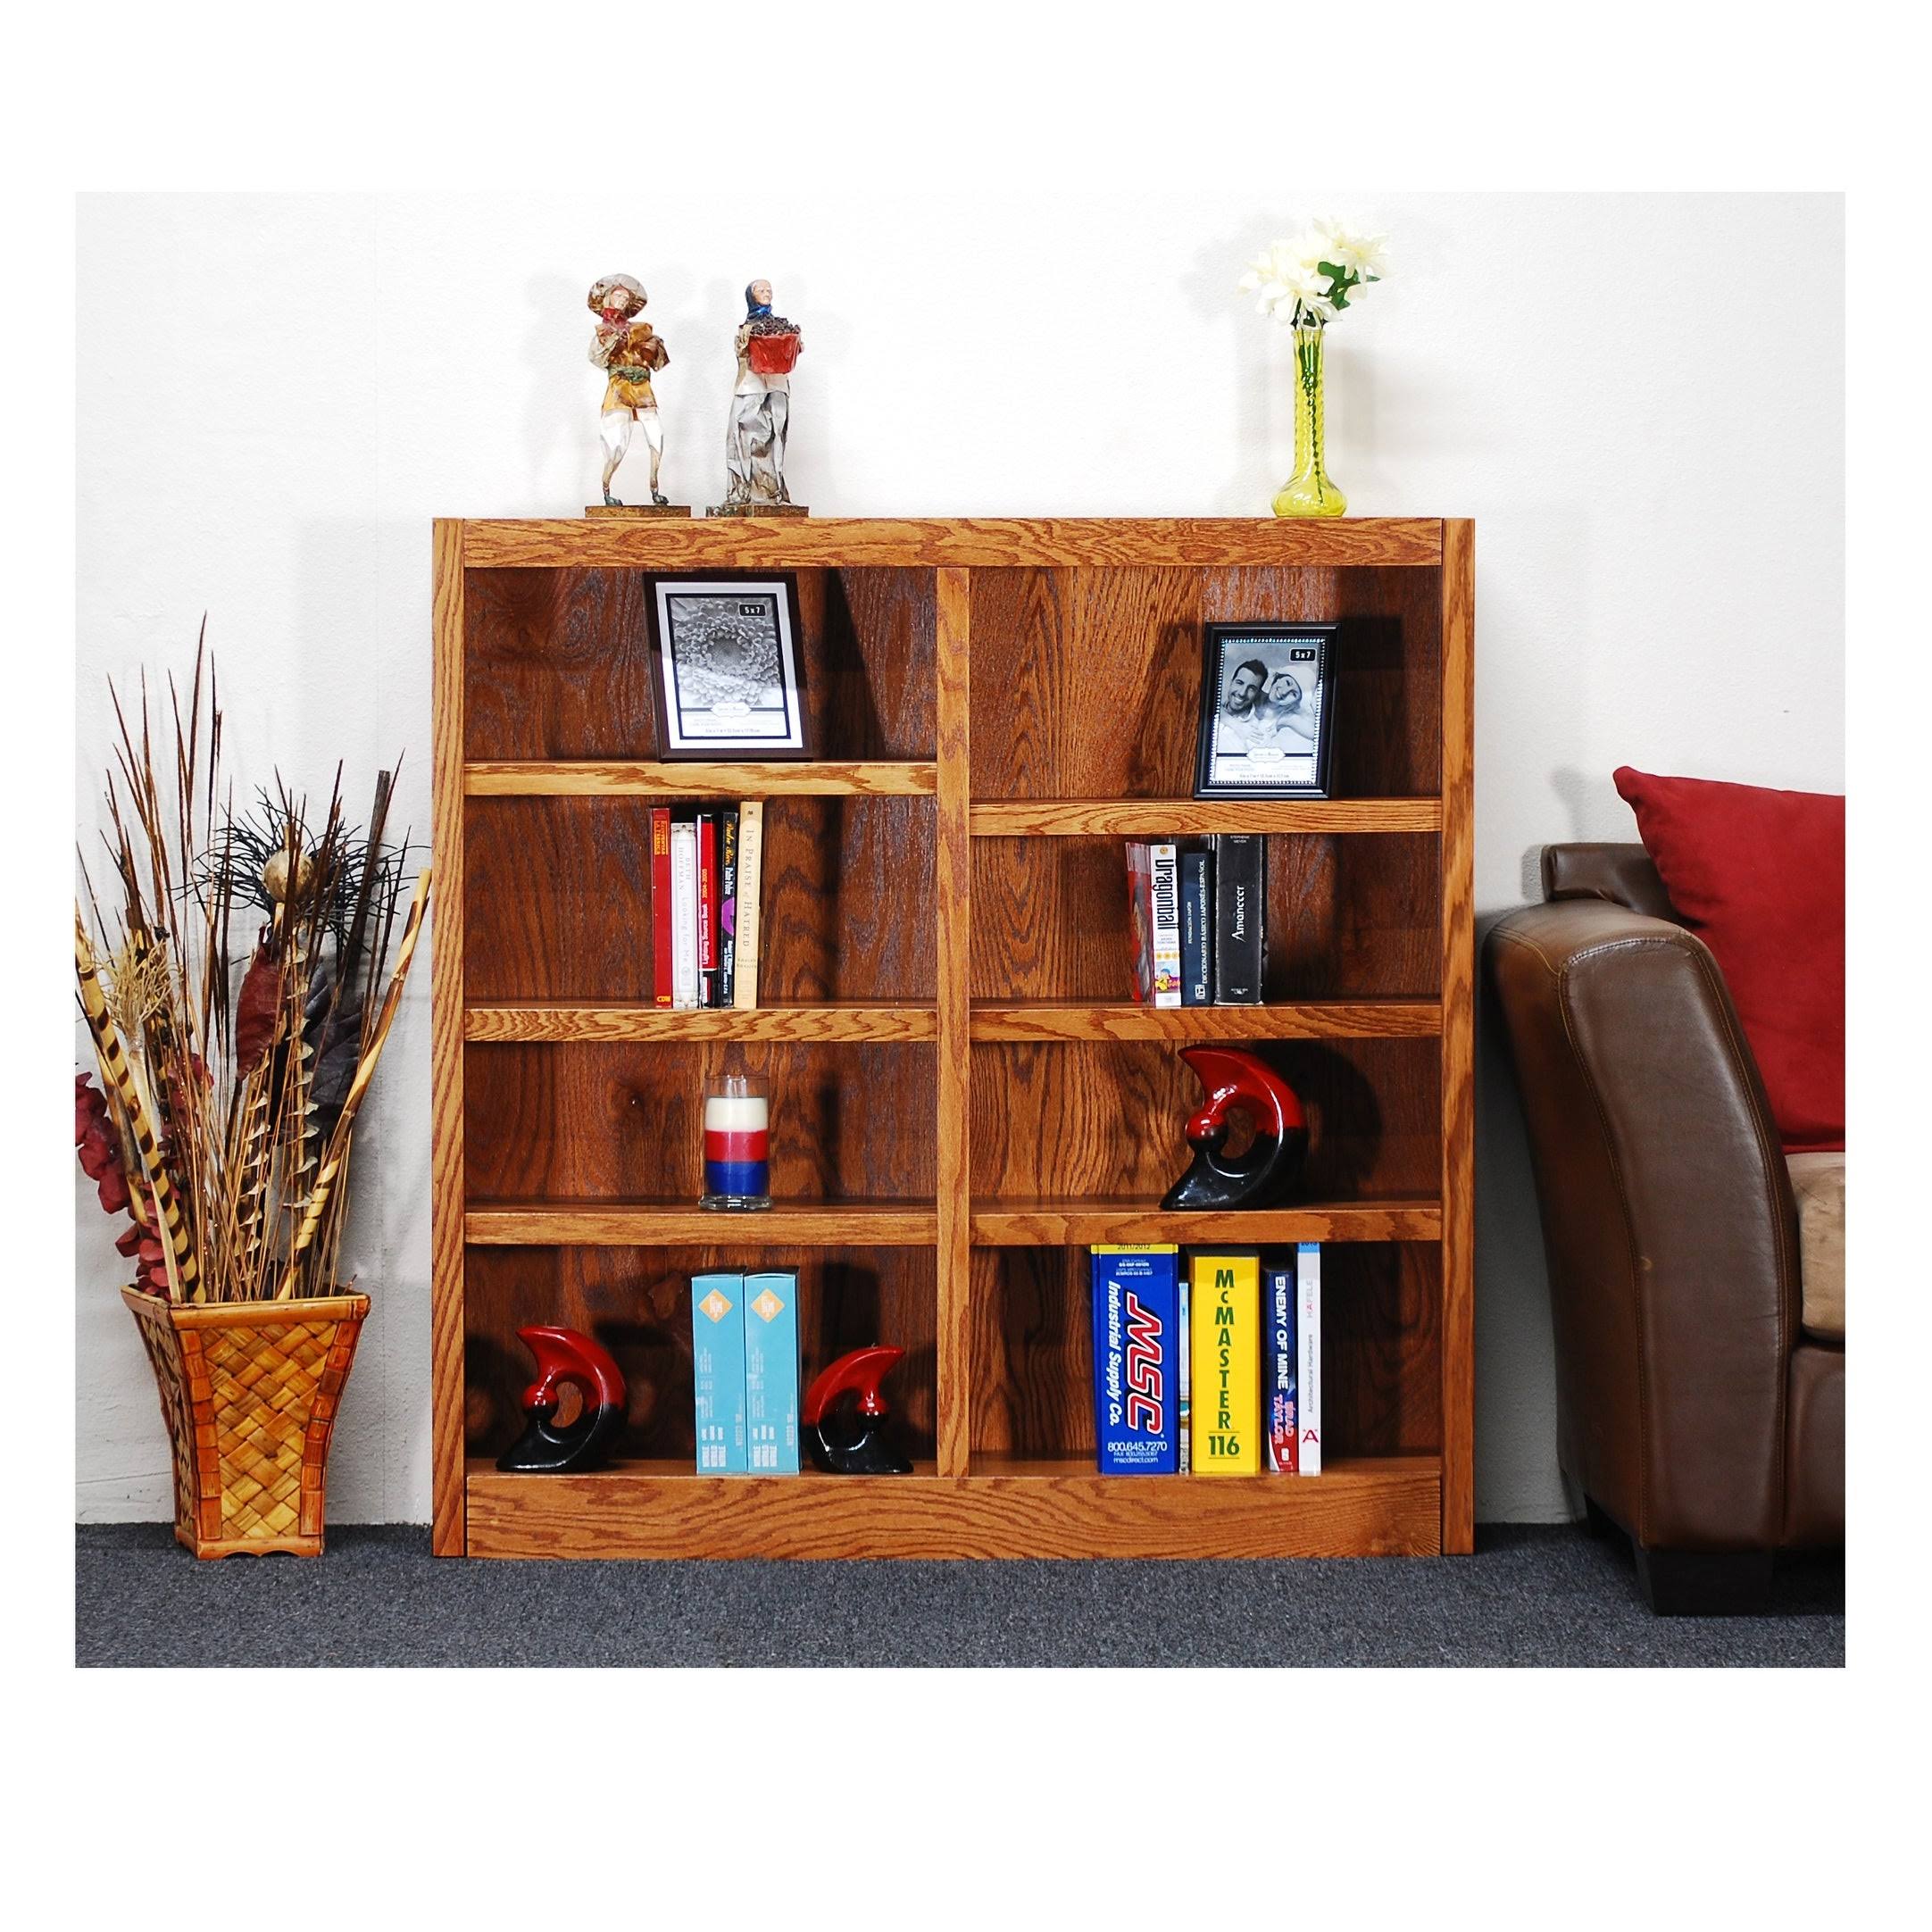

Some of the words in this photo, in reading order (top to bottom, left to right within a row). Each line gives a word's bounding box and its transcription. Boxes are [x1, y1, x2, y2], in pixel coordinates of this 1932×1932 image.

[745, 829, 754, 842] IN
[745, 848, 754, 886] PRAISE
[1153, 859, 1178, 930] Dragonball
[682, 934, 690, 945] for
[743, 902, 753, 946] HATRED
[682, 949, 689, 962] Me
[1108, 1280, 1121, 1351] Industrial
[1275, 1276, 1287, 1327] ENEMY
[1276, 1329, 1288, 1351] OF
[1106, 1351, 1122, 1402] Supply
[1127, 1291, 1162, 1434] MSC
[1277, 1353, 1288, 1390] MINE
[1110, 1403, 1122, 1426] Co.
[1273, 1394, 1285, 1445] TAYLOR
[1107, 1441, 1168, 1453] 800.645.7270
[1208, 1436, 1240, 1455] 116
